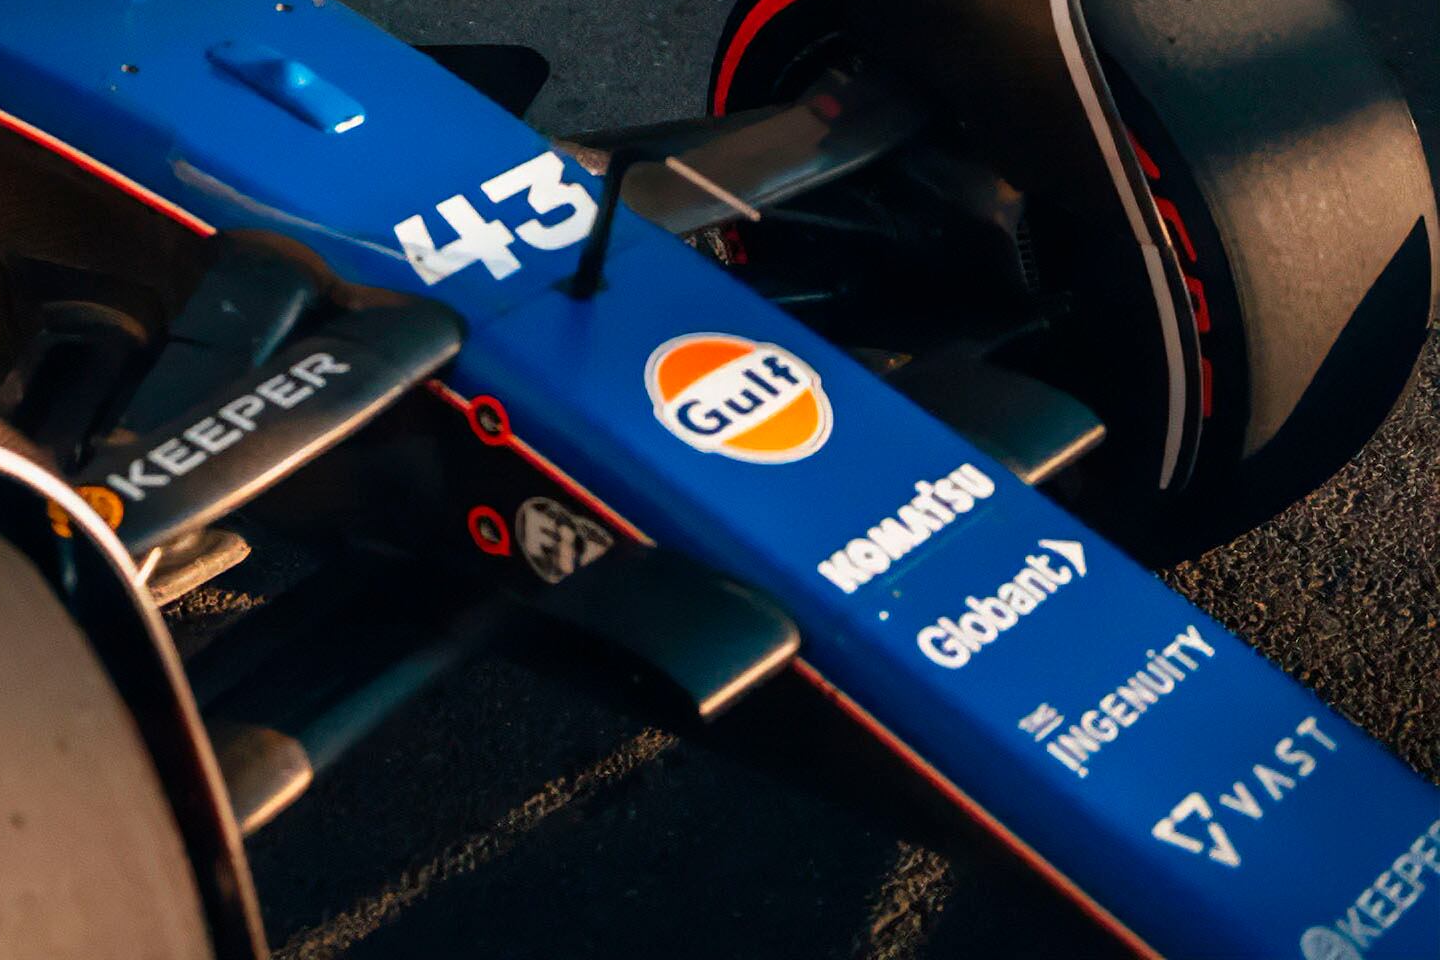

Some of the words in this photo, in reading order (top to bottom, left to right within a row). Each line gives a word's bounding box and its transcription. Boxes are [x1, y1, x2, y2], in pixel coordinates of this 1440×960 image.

[394, 151, 598, 285] 43
[107, 352, 351, 501] KEEPER
[676, 355, 800, 436] Gulf
[817, 463, 995, 594] KOMATSU
[916, 554, 1072, 669] Globant
[1219, 716, 1337, 819] VAST
